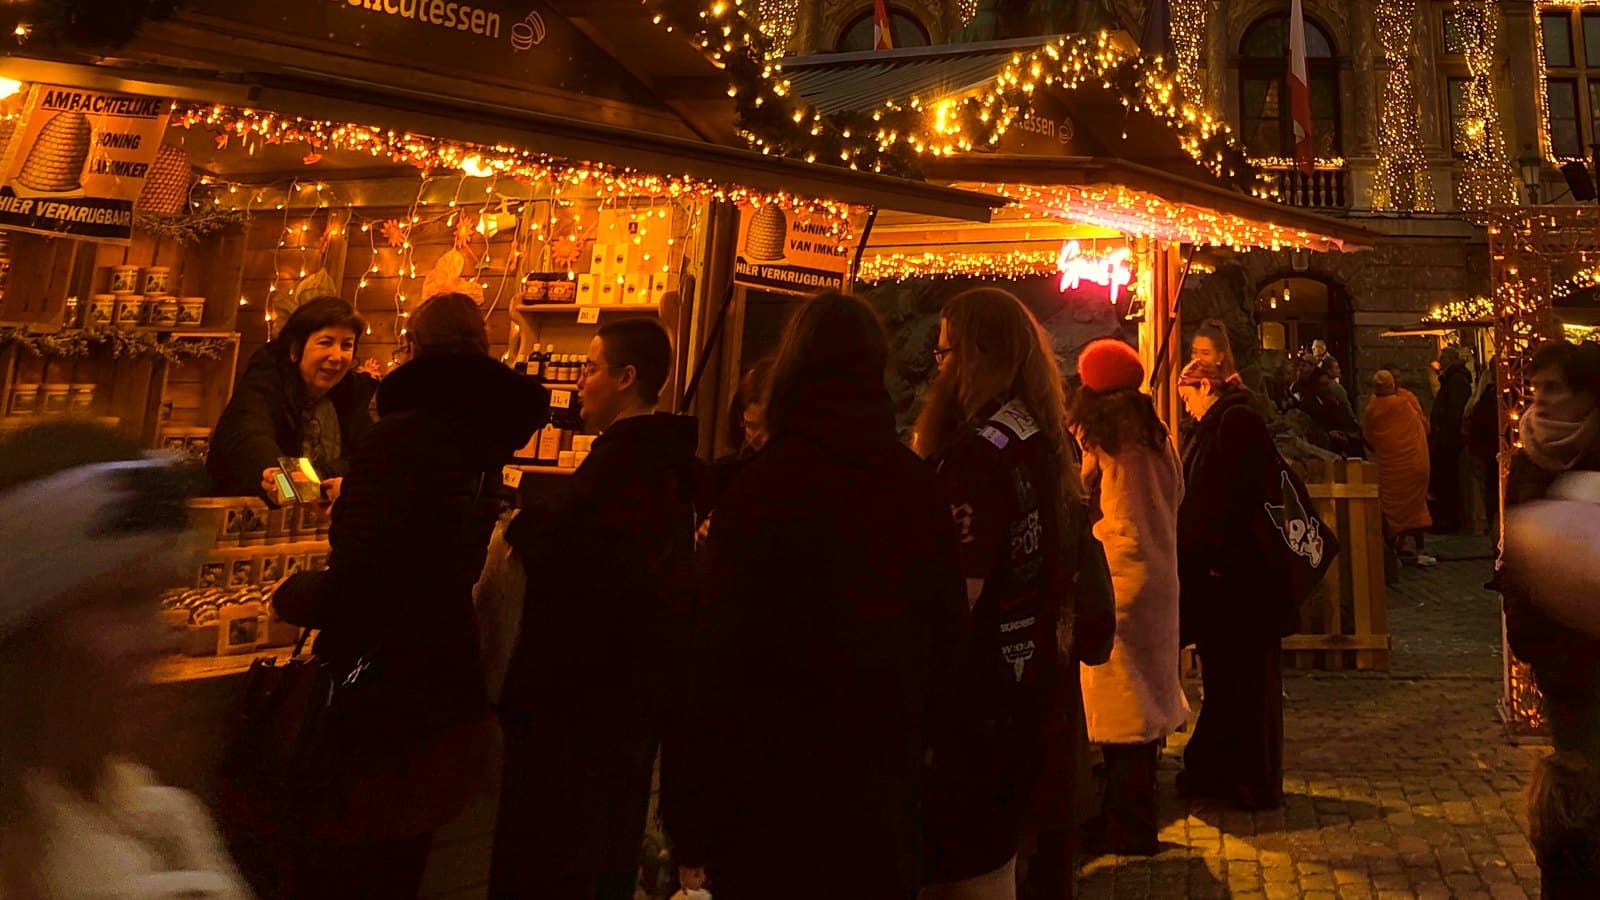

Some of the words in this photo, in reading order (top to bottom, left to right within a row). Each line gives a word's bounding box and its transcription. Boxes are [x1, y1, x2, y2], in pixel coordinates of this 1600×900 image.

[0, 195, 34, 215] HIER
[37, 200, 131, 226] VERKRIJGBAAR
[791, 239, 812, 252] VAN
[736, 262, 758, 277] HIER
[761, 267, 841, 289] VERKRIJGBAAR
